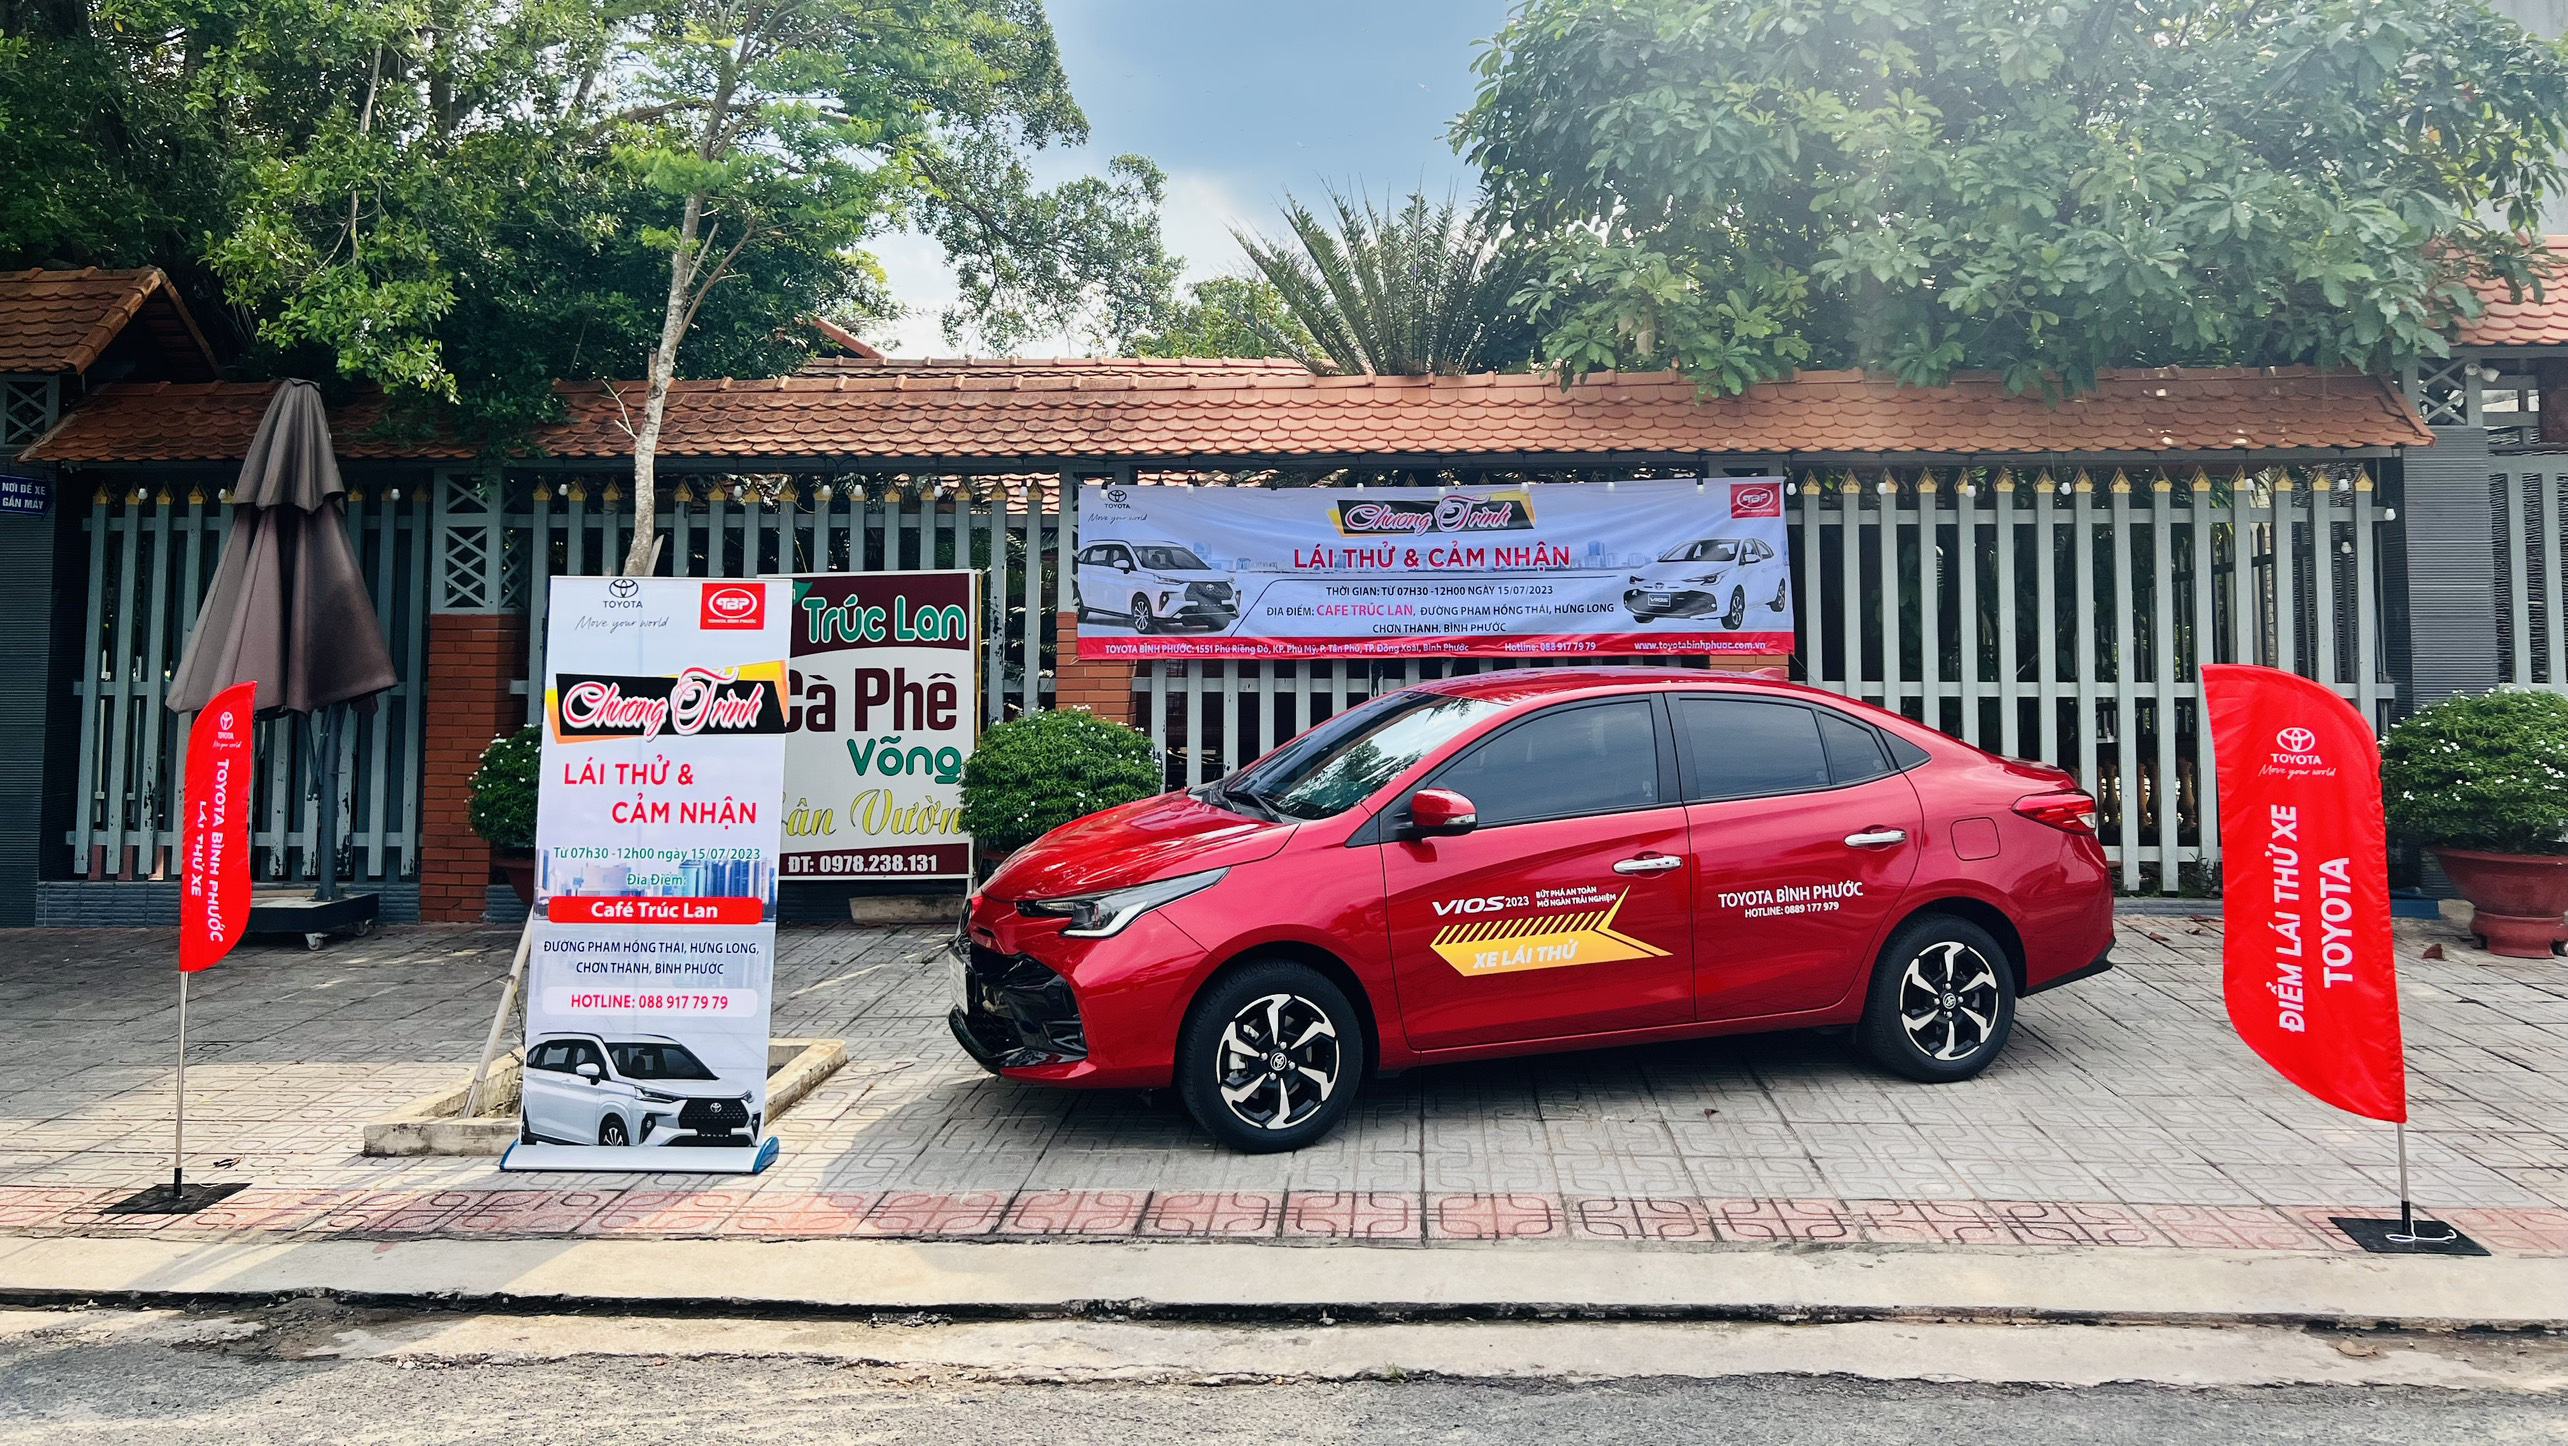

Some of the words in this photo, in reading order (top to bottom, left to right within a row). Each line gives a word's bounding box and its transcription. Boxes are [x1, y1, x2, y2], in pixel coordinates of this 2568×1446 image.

[34, 486, 46, 495] XE
[1088, 513, 1108, 522] Move
[1434, 494, 1513, 533] Trình
[1294, 543, 1334, 569] LÁI
[1342, 541, 1396, 568] THỬ
[1403, 550, 1419, 568] &
[1428, 540, 1485, 568] CẢM
[1495, 540, 1569, 571] NHẬN
[1326, 586, 1350, 596] THỜI
[1352, 587, 1380, 596] GIAN:
[1381, 586, 1394, 596] TỪ
[1397, 587, 1429, 596] 07H30
[1468, 585, 1495, 596] NGÀY
[1498, 585, 1553, 596] 15/07/2023
[603, 600, 643, 609] TOYOTA
[716, 597, 750, 610] TBP
[1316, 604, 1349, 616] CAFE
[1351, 602, 1384, 616] TRÚC
[1420, 606, 1458, 616] ĐƯỜNG
[1461, 605, 1491, 618] PHẠM
[1525, 603, 1552, 616] THÁI,
[1554, 603, 1584, 614] HƯNG
[1586, 603, 1615, 613] LONG
[575, 615, 608, 631] Move
[612, 619, 636, 634] your
[640, 616, 670, 628] world
[802, 593, 886, 643] Trúc
[895, 595, 966, 641] Lan
[1373, 623, 1401, 634] CHƠN
[1444, 622, 1468, 633] BÌNH
[1471, 622, 1507, 632] PHƯỚC
[1105, 644, 1137, 654] TOYOTA
[1139, 643, 1161, 653] BÌNH
[1196, 645, 1213, 654] 1551
[1215, 644, 1231, 654] Phú
[1328, 643, 1343, 653] Tân
[1364, 643, 1376, 653] TP.
[1423, 642, 1442, 652] Bình
[1504, 642, 1539, 652] Hotline:
[1540, 642, 1556, 651] 088
[1557, 642, 1571, 651] 917
[1572, 642, 1584, 650] 79
[1585, 641, 1596, 650] 79
[671, 666, 765, 736] Trình
[854, 667, 957, 731] Phê
[564, 757, 605, 785] LÁI
[615, 754, 670, 785] THỬ
[677, 763, 694, 785] &
[846, 736, 962, 784] Võng
[2270, 753, 2322, 765] TOYOTA
[2258, 764, 2287, 777] Move
[2287, 769, 2310, 780] your
[2312, 767, 2336, 777] world
[213, 759, 229, 827] TOYOTA
[197, 800, 207, 828] LÁI
[611, 792, 670, 824] CẢM
[680, 795, 757, 830] NHẬN
[782, 792, 836, 836] ân
[850, 789, 962, 836] Vườn
[2270, 804, 2298, 842] XE
[191, 832, 204, 873] THỬ
[210, 832, 224, 875] BÌNH
[554, 847, 569, 858] Từ
[570, 847, 609, 859] 07h30
[657, 848, 688, 863] ngày
[691, 847, 761, 860] 15/07/2023
[788, 855, 815, 873] ĐT:
[819, 855, 937, 873] 0978.238.131
[191, 873, 202, 897] XE
[2264, 843, 2299, 904] THỬ
[1550, 897, 1571, 906] NGÀN
[1551, 887, 1565, 897] PHÁ
[1566, 888, 1577, 896] AN
[1577, 886, 1597, 895] TOÀN
[1717, 890, 1773, 908] TOYOTA
[1776, 885, 1810, 903] BÌNH
[1813, 880, 1864, 900] PHƯỚC
[207, 879, 226, 942] PHƯỚC
[591, 900, 634, 918] Café
[637, 901, 679, 918] Trúc
[683, 904, 719, 918] Lan
[1432, 895, 1505, 916] VIOS
[1505, 896, 1529, 908] 2023
[1744, 906, 1784, 918] HOTLINE:
[1784, 904, 1805, 915] 0889
[1806, 902, 1822, 913] 177
[1823, 901, 1840, 912] 979
[2268, 911, 2302, 957] LÁI
[2318, 857, 2353, 988] TOYOTA
[543, 940, 585, 953] ĐƯỜNG
[587, 941, 621, 955] PHẠM
[659, 941, 687, 955] THÁI,
[690, 942, 723, 954] HƯNG
[726, 942, 760, 955] LONG,
[1473, 952, 1498, 969] XE
[1501, 944, 1533, 966] LÁI
[1537, 938, 1579, 963] THỬ
[576, 961, 608, 973] CHƠN
[611, 961, 652, 975] THÀNH,
[655, 961, 681, 974] BÌNH
[684, 961, 724, 974] PHƯỚC
[571, 994, 635, 1009] HOTLINE:
[639, 995, 663, 1009] 088
[666, 995, 689, 1009] 917
[693, 996, 709, 1009] 79
[712, 996, 728, 1010] 79
[2266, 962, 2305, 1032] ĐIỂM
